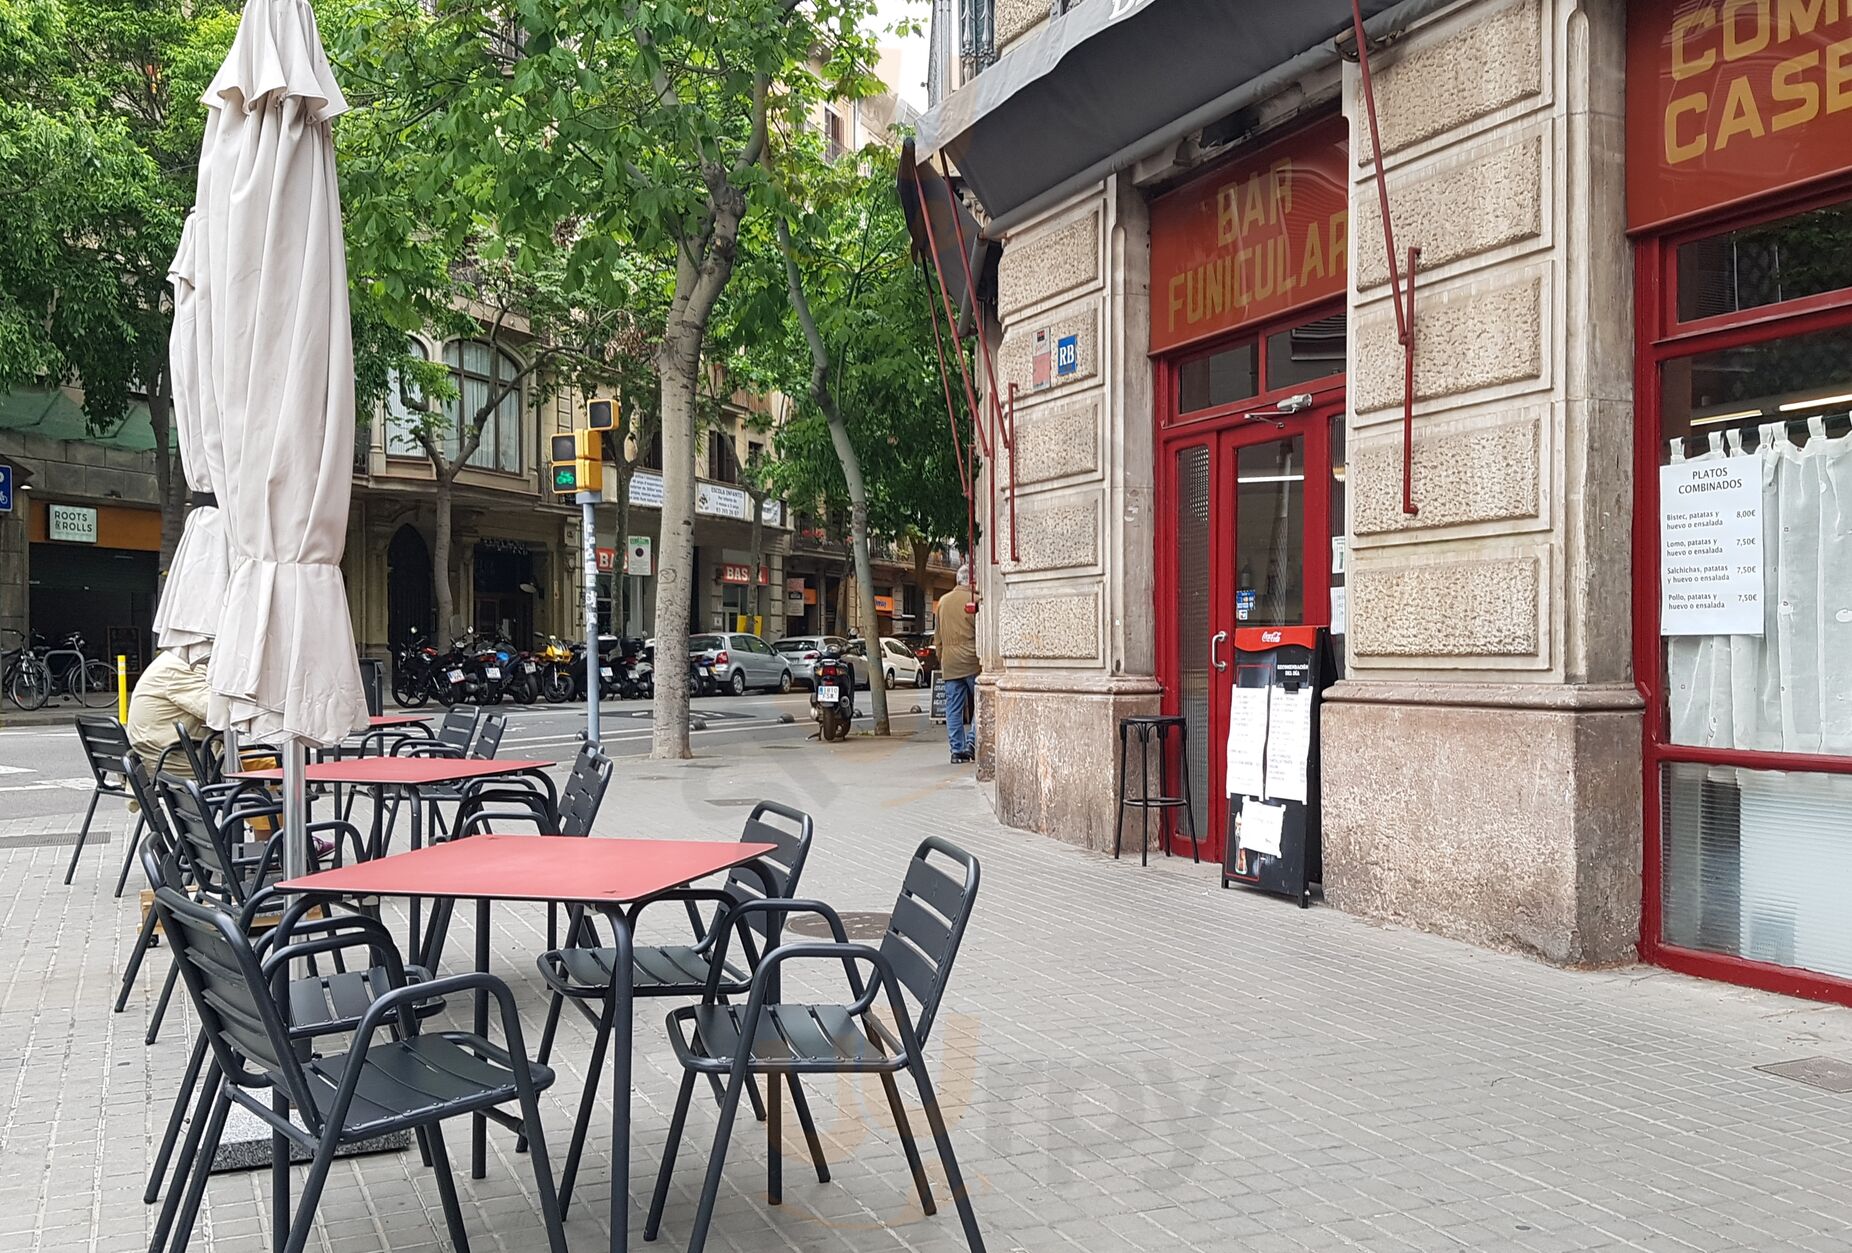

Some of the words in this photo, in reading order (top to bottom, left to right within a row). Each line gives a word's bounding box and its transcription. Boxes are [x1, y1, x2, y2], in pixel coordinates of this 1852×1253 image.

[1217, 157, 1292, 249] BAR
[1168, 209, 1347, 333] FUNICULAR
[1059, 344, 1075, 367] RB
[1692, 467, 1728, 480] PLATOS
[1678, 478, 1742, 494] COMBINADOS
[54, 511, 87, 521] ROOTS
[1666, 513, 1688, 521] Bistec,
[1689, 511, 1713, 521] patatas
[1736, 509, 1756, 519] 8,00€
[62, 522, 92, 532] ROLLS
[1693, 518, 1723, 528] ensalada
[1687, 539, 1711, 547] patatas
[1736, 538, 1756, 547] 7,50€
[1693, 547, 1723, 555] ensalada
[1667, 566, 1702, 575] Salchichas,
[1703, 565, 1728, 573] patatas
[1737, 566, 1756, 575] 7,50€
[1700, 574, 1730, 582] ensalada
[1668, 593, 1686, 601] Pollo,
[1687, 593, 1711, 602] patatas
[1737, 593, 1757, 602] 7,50€
[1695, 601, 1725, 609] ensalada
